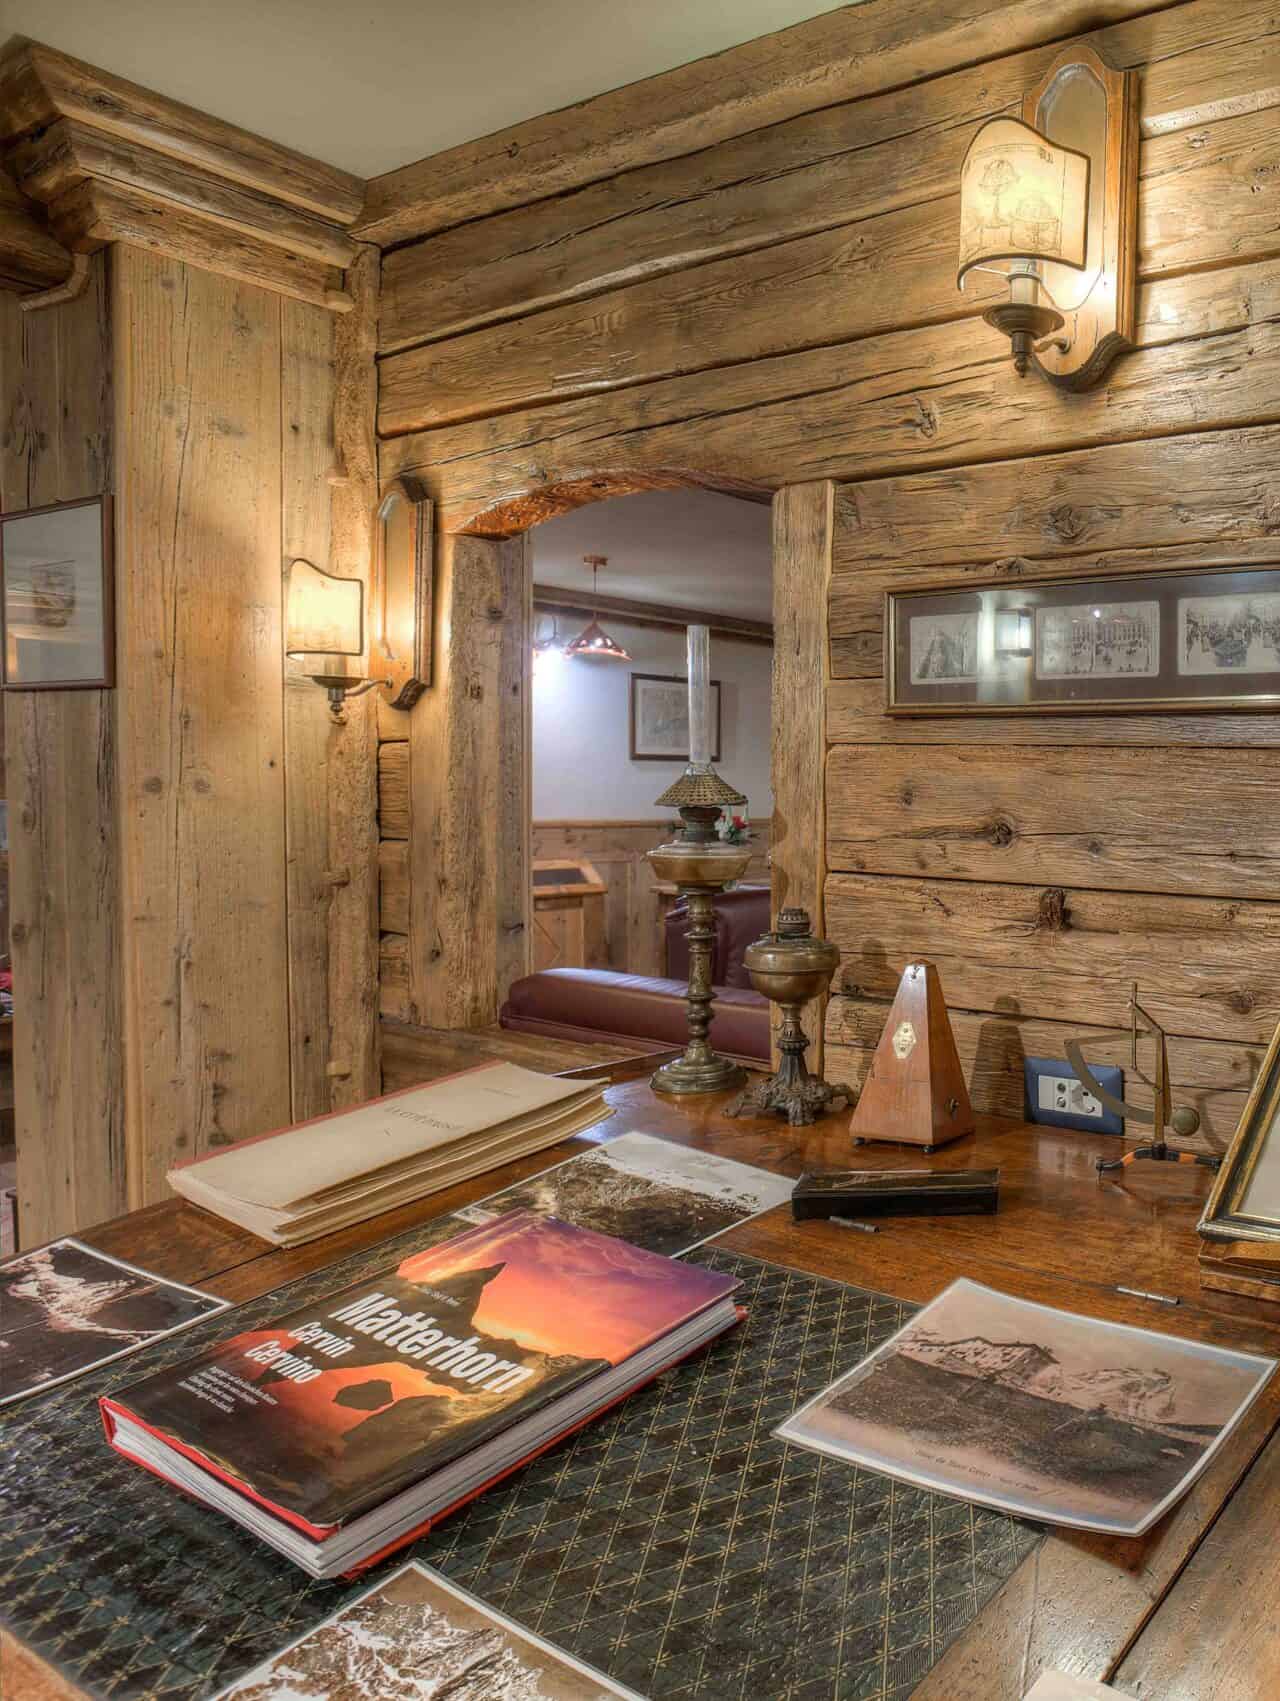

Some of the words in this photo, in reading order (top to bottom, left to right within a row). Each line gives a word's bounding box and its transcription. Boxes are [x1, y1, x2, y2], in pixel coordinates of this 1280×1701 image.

[244, 1340, 324, 1385] Cervino
[286, 1321, 357, 1360] Cervin
[328, 1293, 534, 1393] Matterhorn
